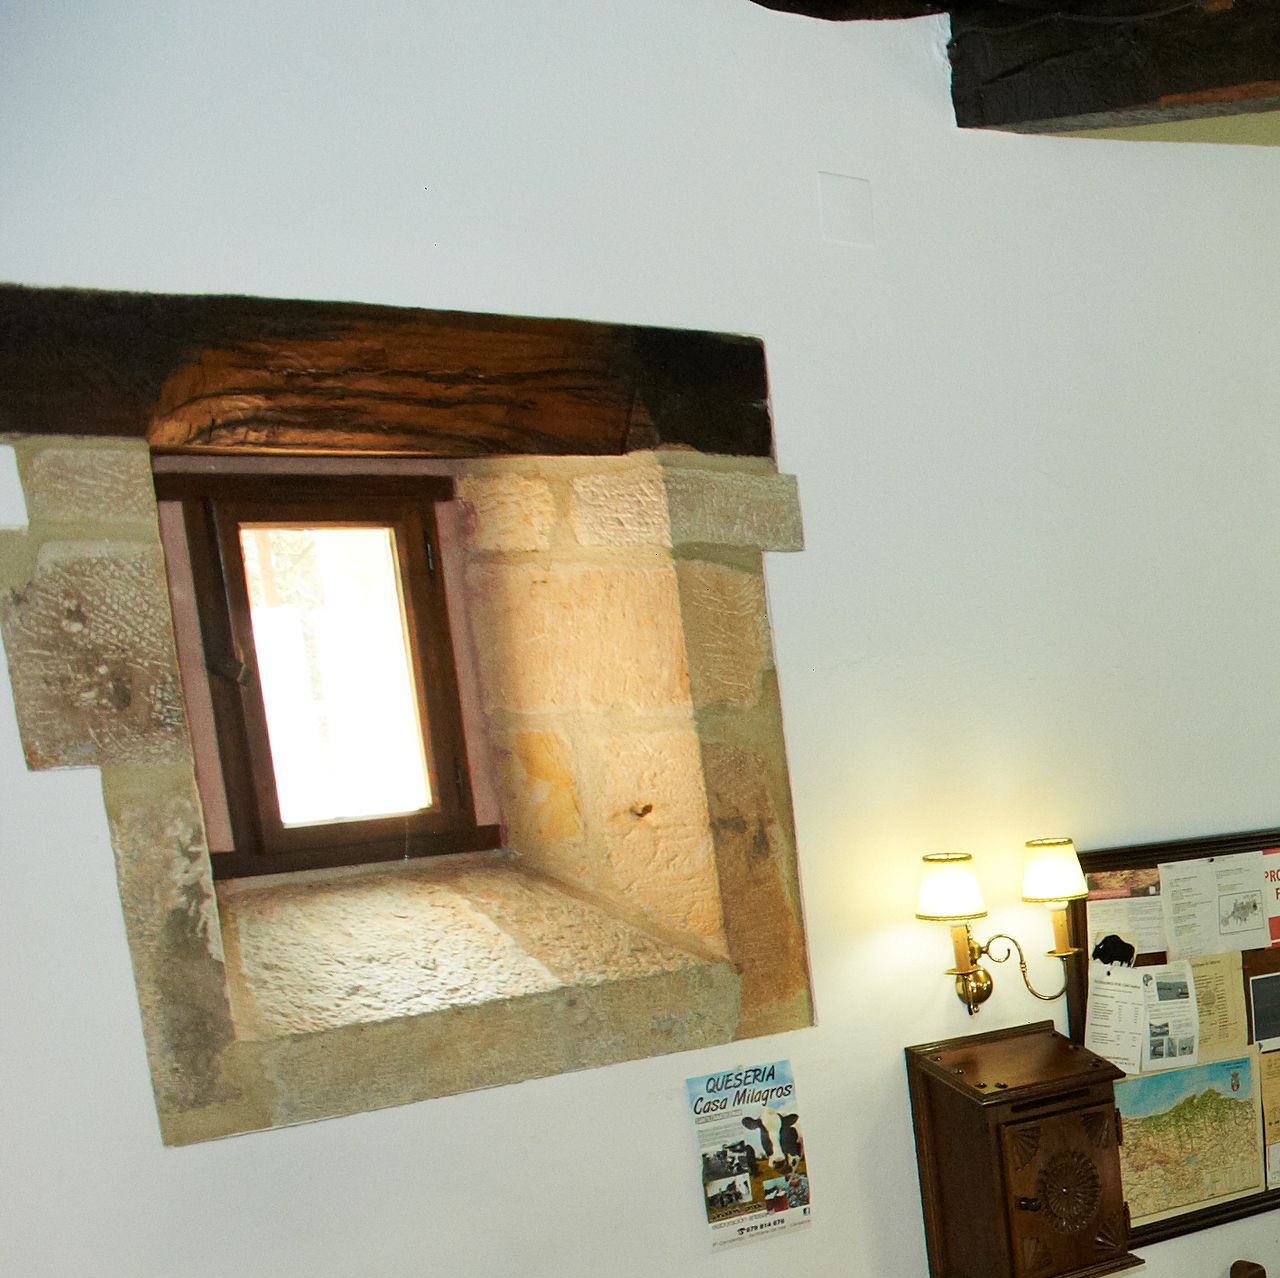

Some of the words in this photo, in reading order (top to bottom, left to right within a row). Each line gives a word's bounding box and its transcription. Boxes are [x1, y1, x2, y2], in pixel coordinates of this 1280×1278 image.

[705, 1065, 775, 1094] QUESERIA
[693, 1096, 727, 1116] Casa
[732, 1083, 793, 1107] Milagros
